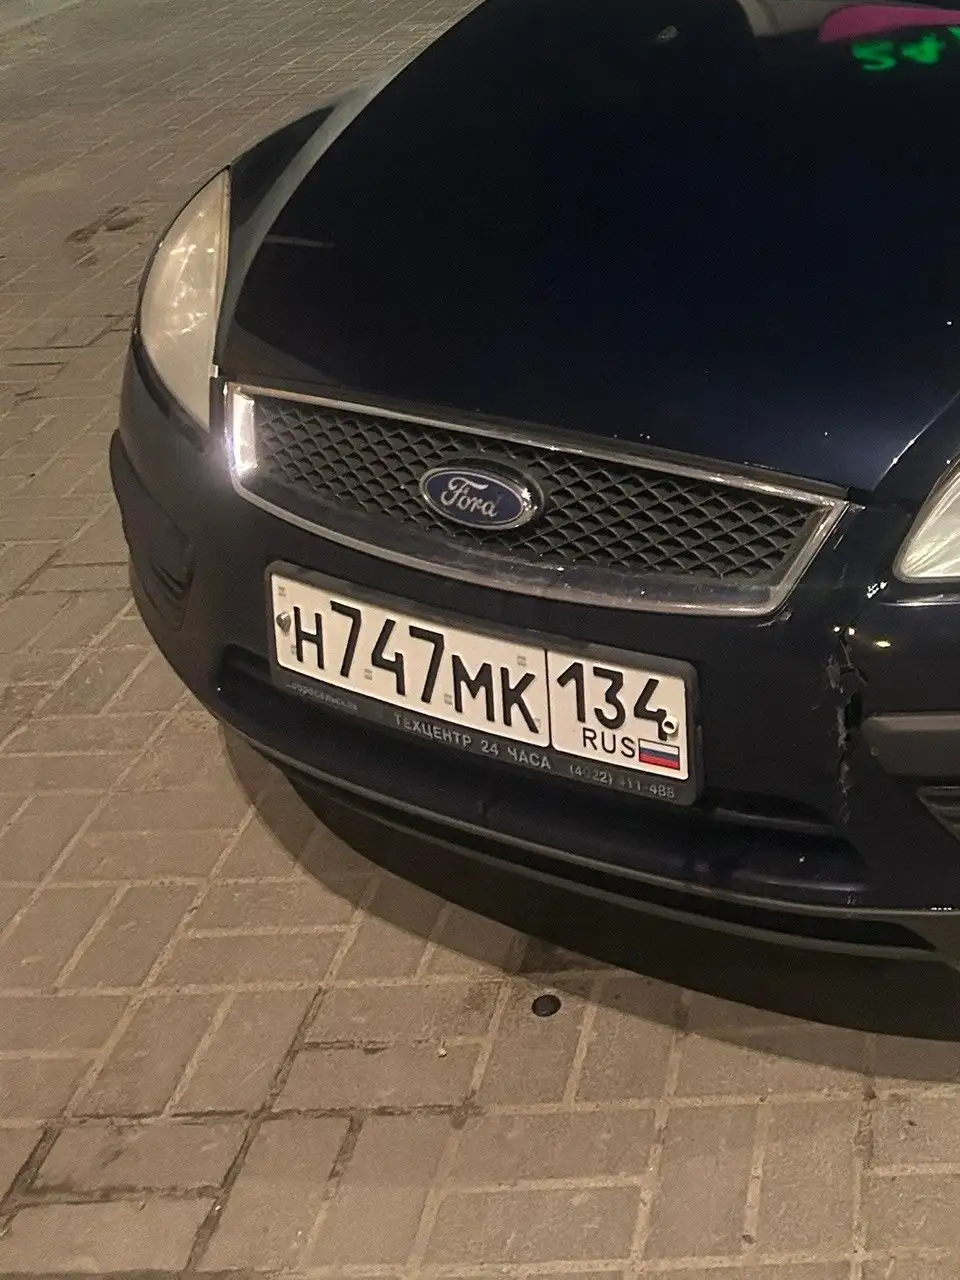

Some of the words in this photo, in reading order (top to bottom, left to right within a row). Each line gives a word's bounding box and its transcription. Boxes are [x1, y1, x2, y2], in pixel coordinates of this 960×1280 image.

[440, 476, 501, 518] Ford
[293, 599, 540, 735] Н747МК
[556, 660, 670, 741] 134
[393, 712, 473, 749] ТЕХЦЕНТР
[480, 739, 500, 757] 24
[507, 746, 552, 770] ЧАСА
[581, 726, 636, 759] RUS
